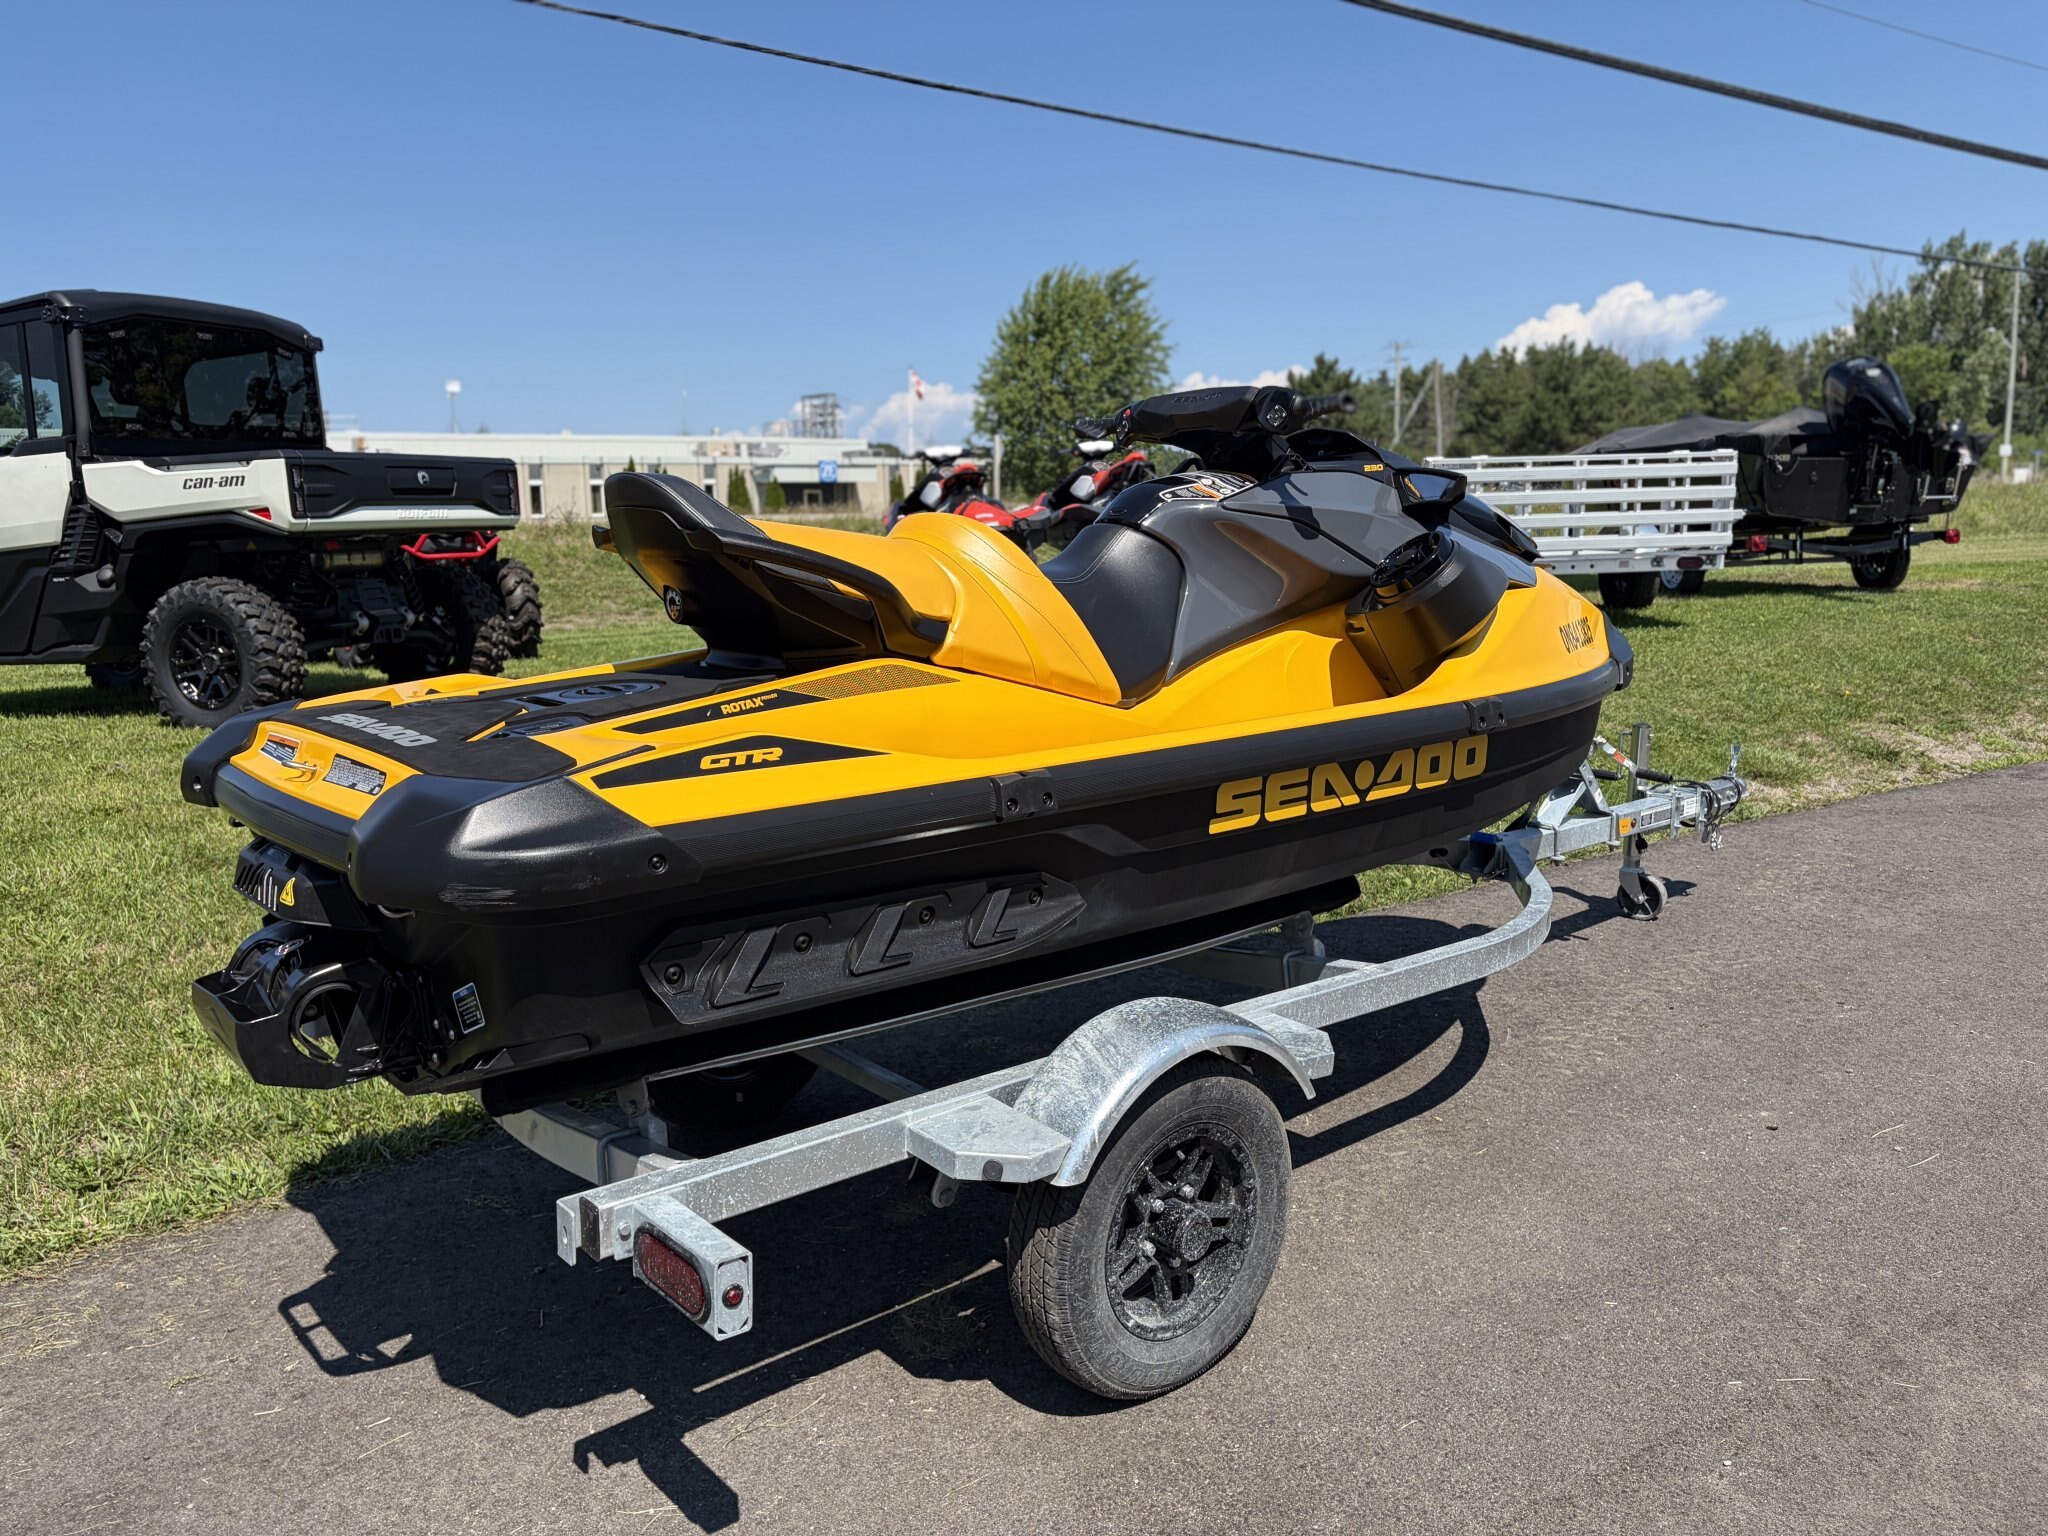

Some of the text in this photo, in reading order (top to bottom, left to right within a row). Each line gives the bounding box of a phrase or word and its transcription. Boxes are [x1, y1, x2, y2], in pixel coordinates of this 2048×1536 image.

[1364, 464, 1383, 472] 230
[183, 475, 246, 490] can-am
[720, 697, 764, 715] ROTAX
[700, 747, 783, 770] GTR
